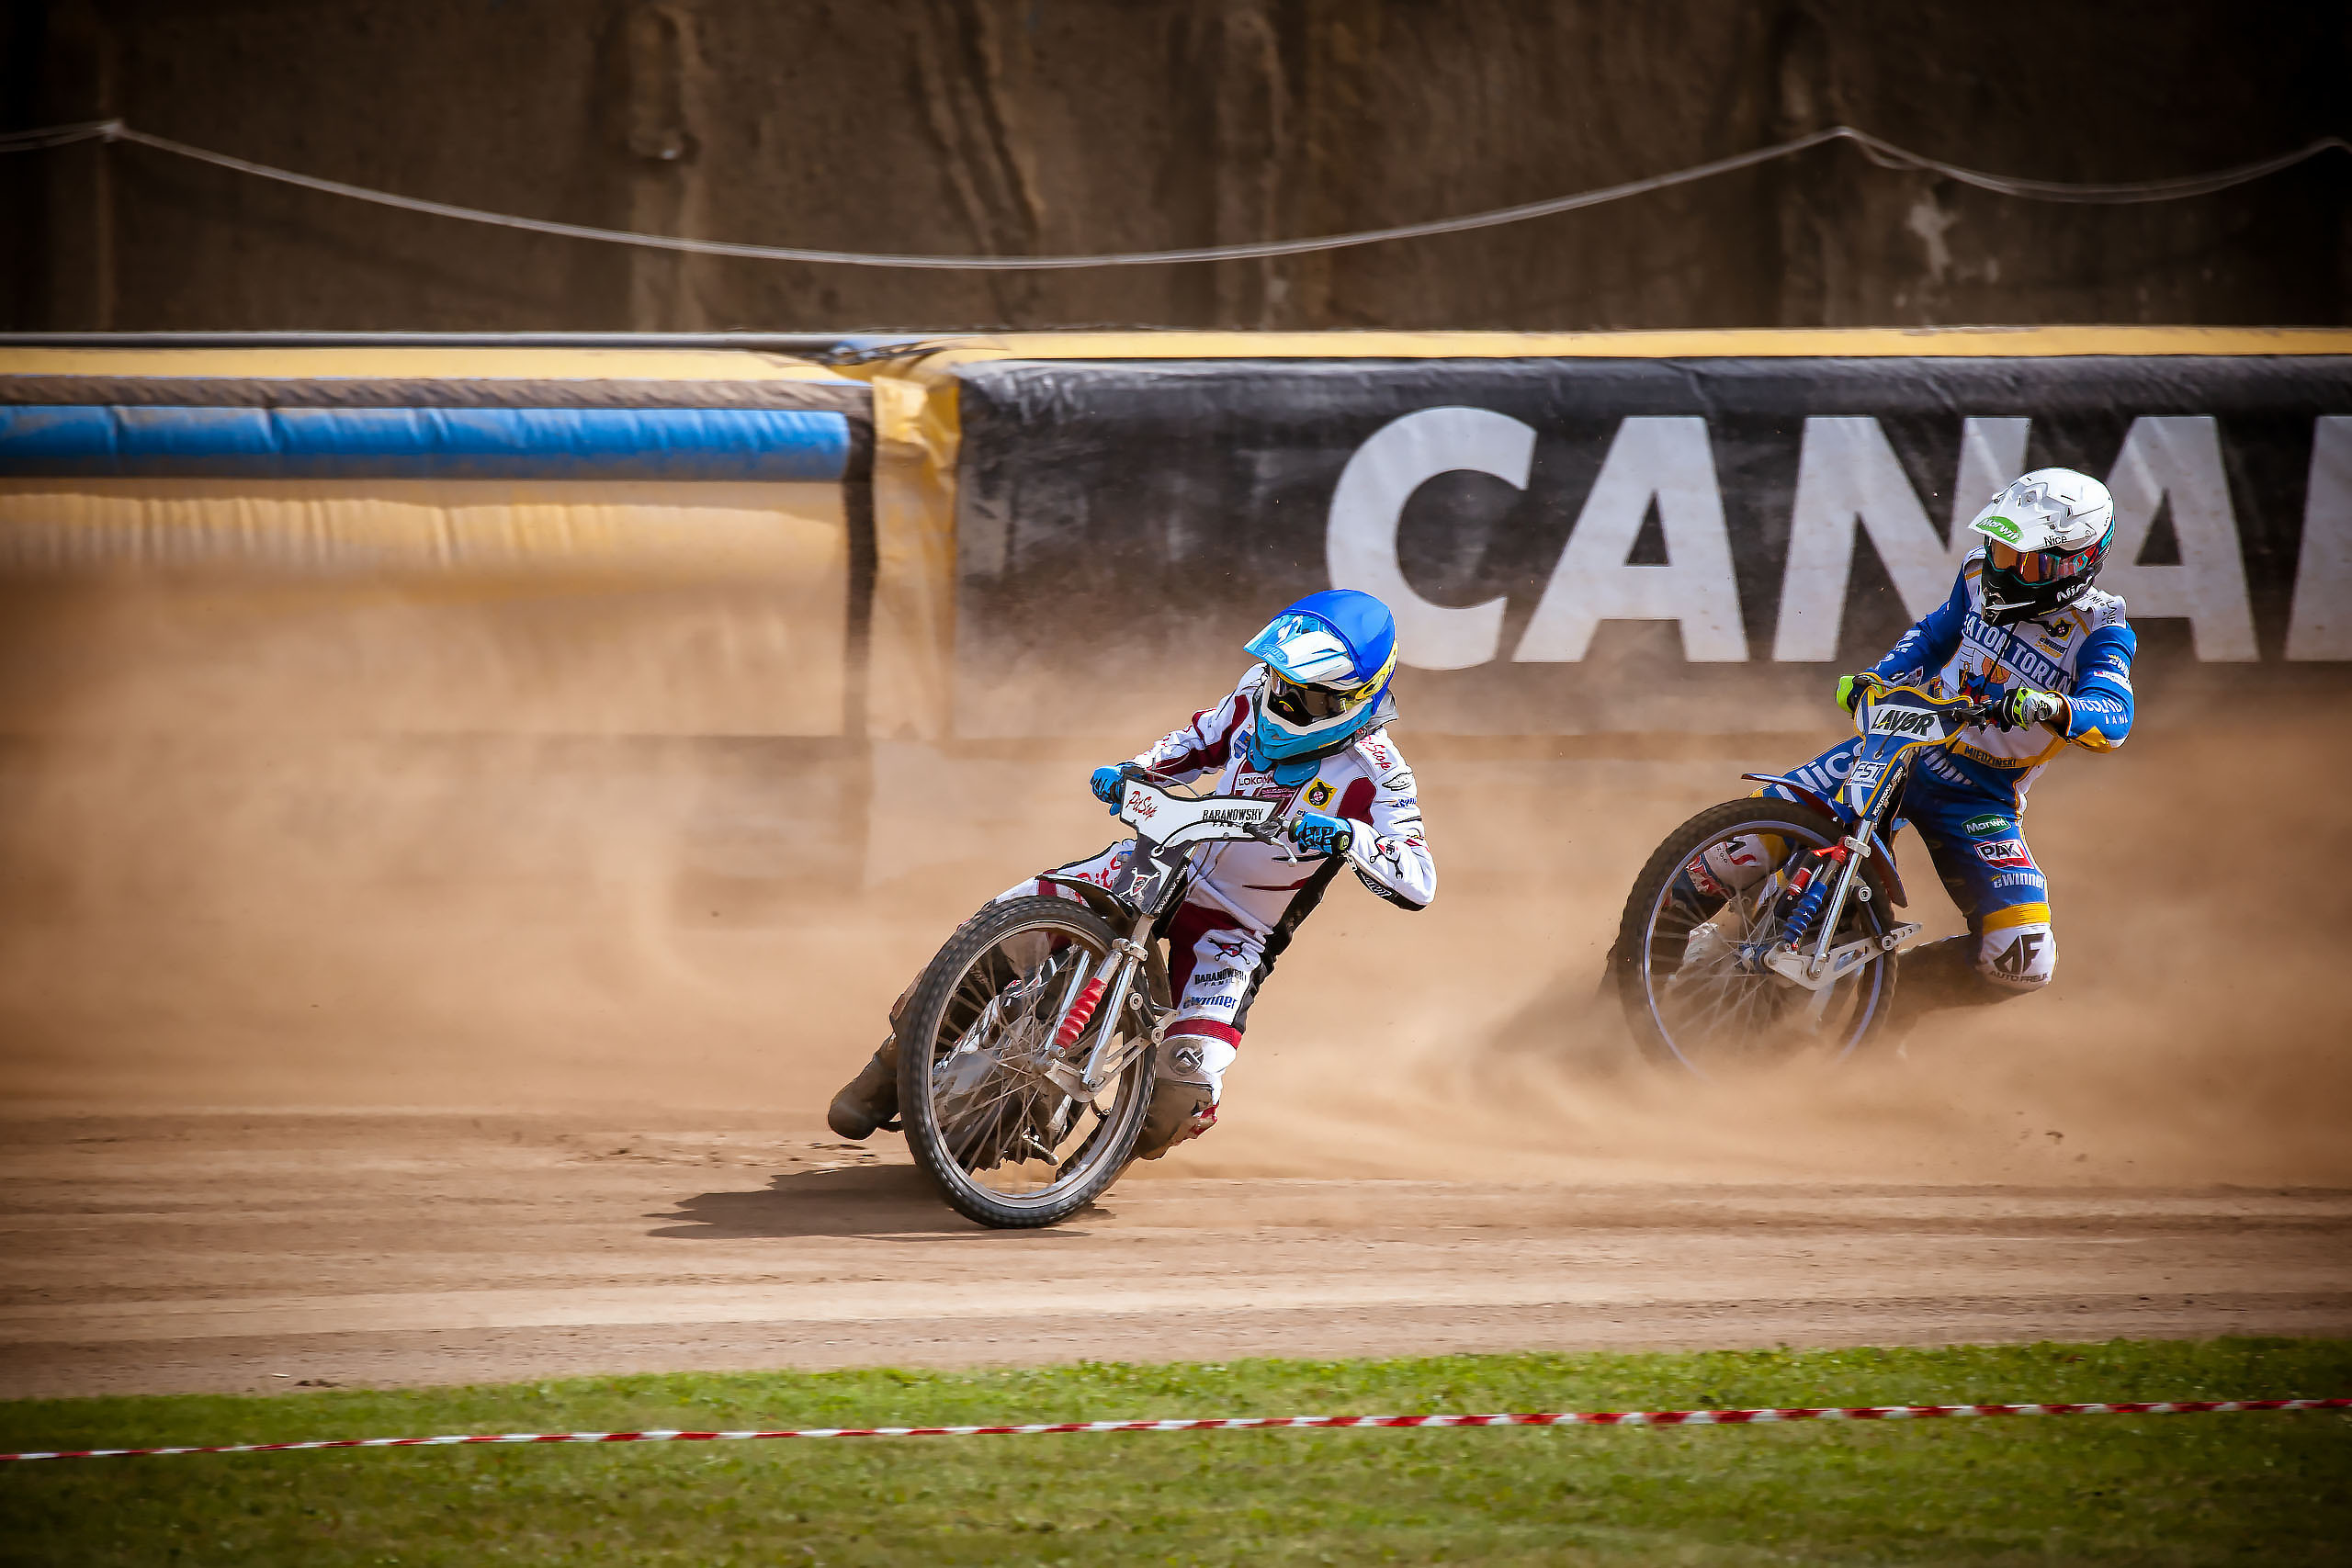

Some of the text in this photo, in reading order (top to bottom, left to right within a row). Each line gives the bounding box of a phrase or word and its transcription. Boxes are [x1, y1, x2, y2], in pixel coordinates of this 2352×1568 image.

[1978, 516, 2020, 541] Marwit
[2044, 535, 2068, 547] Nice
[1966, 818, 2008, 834] Marwit
[1980, 842, 2021, 859] PAK
